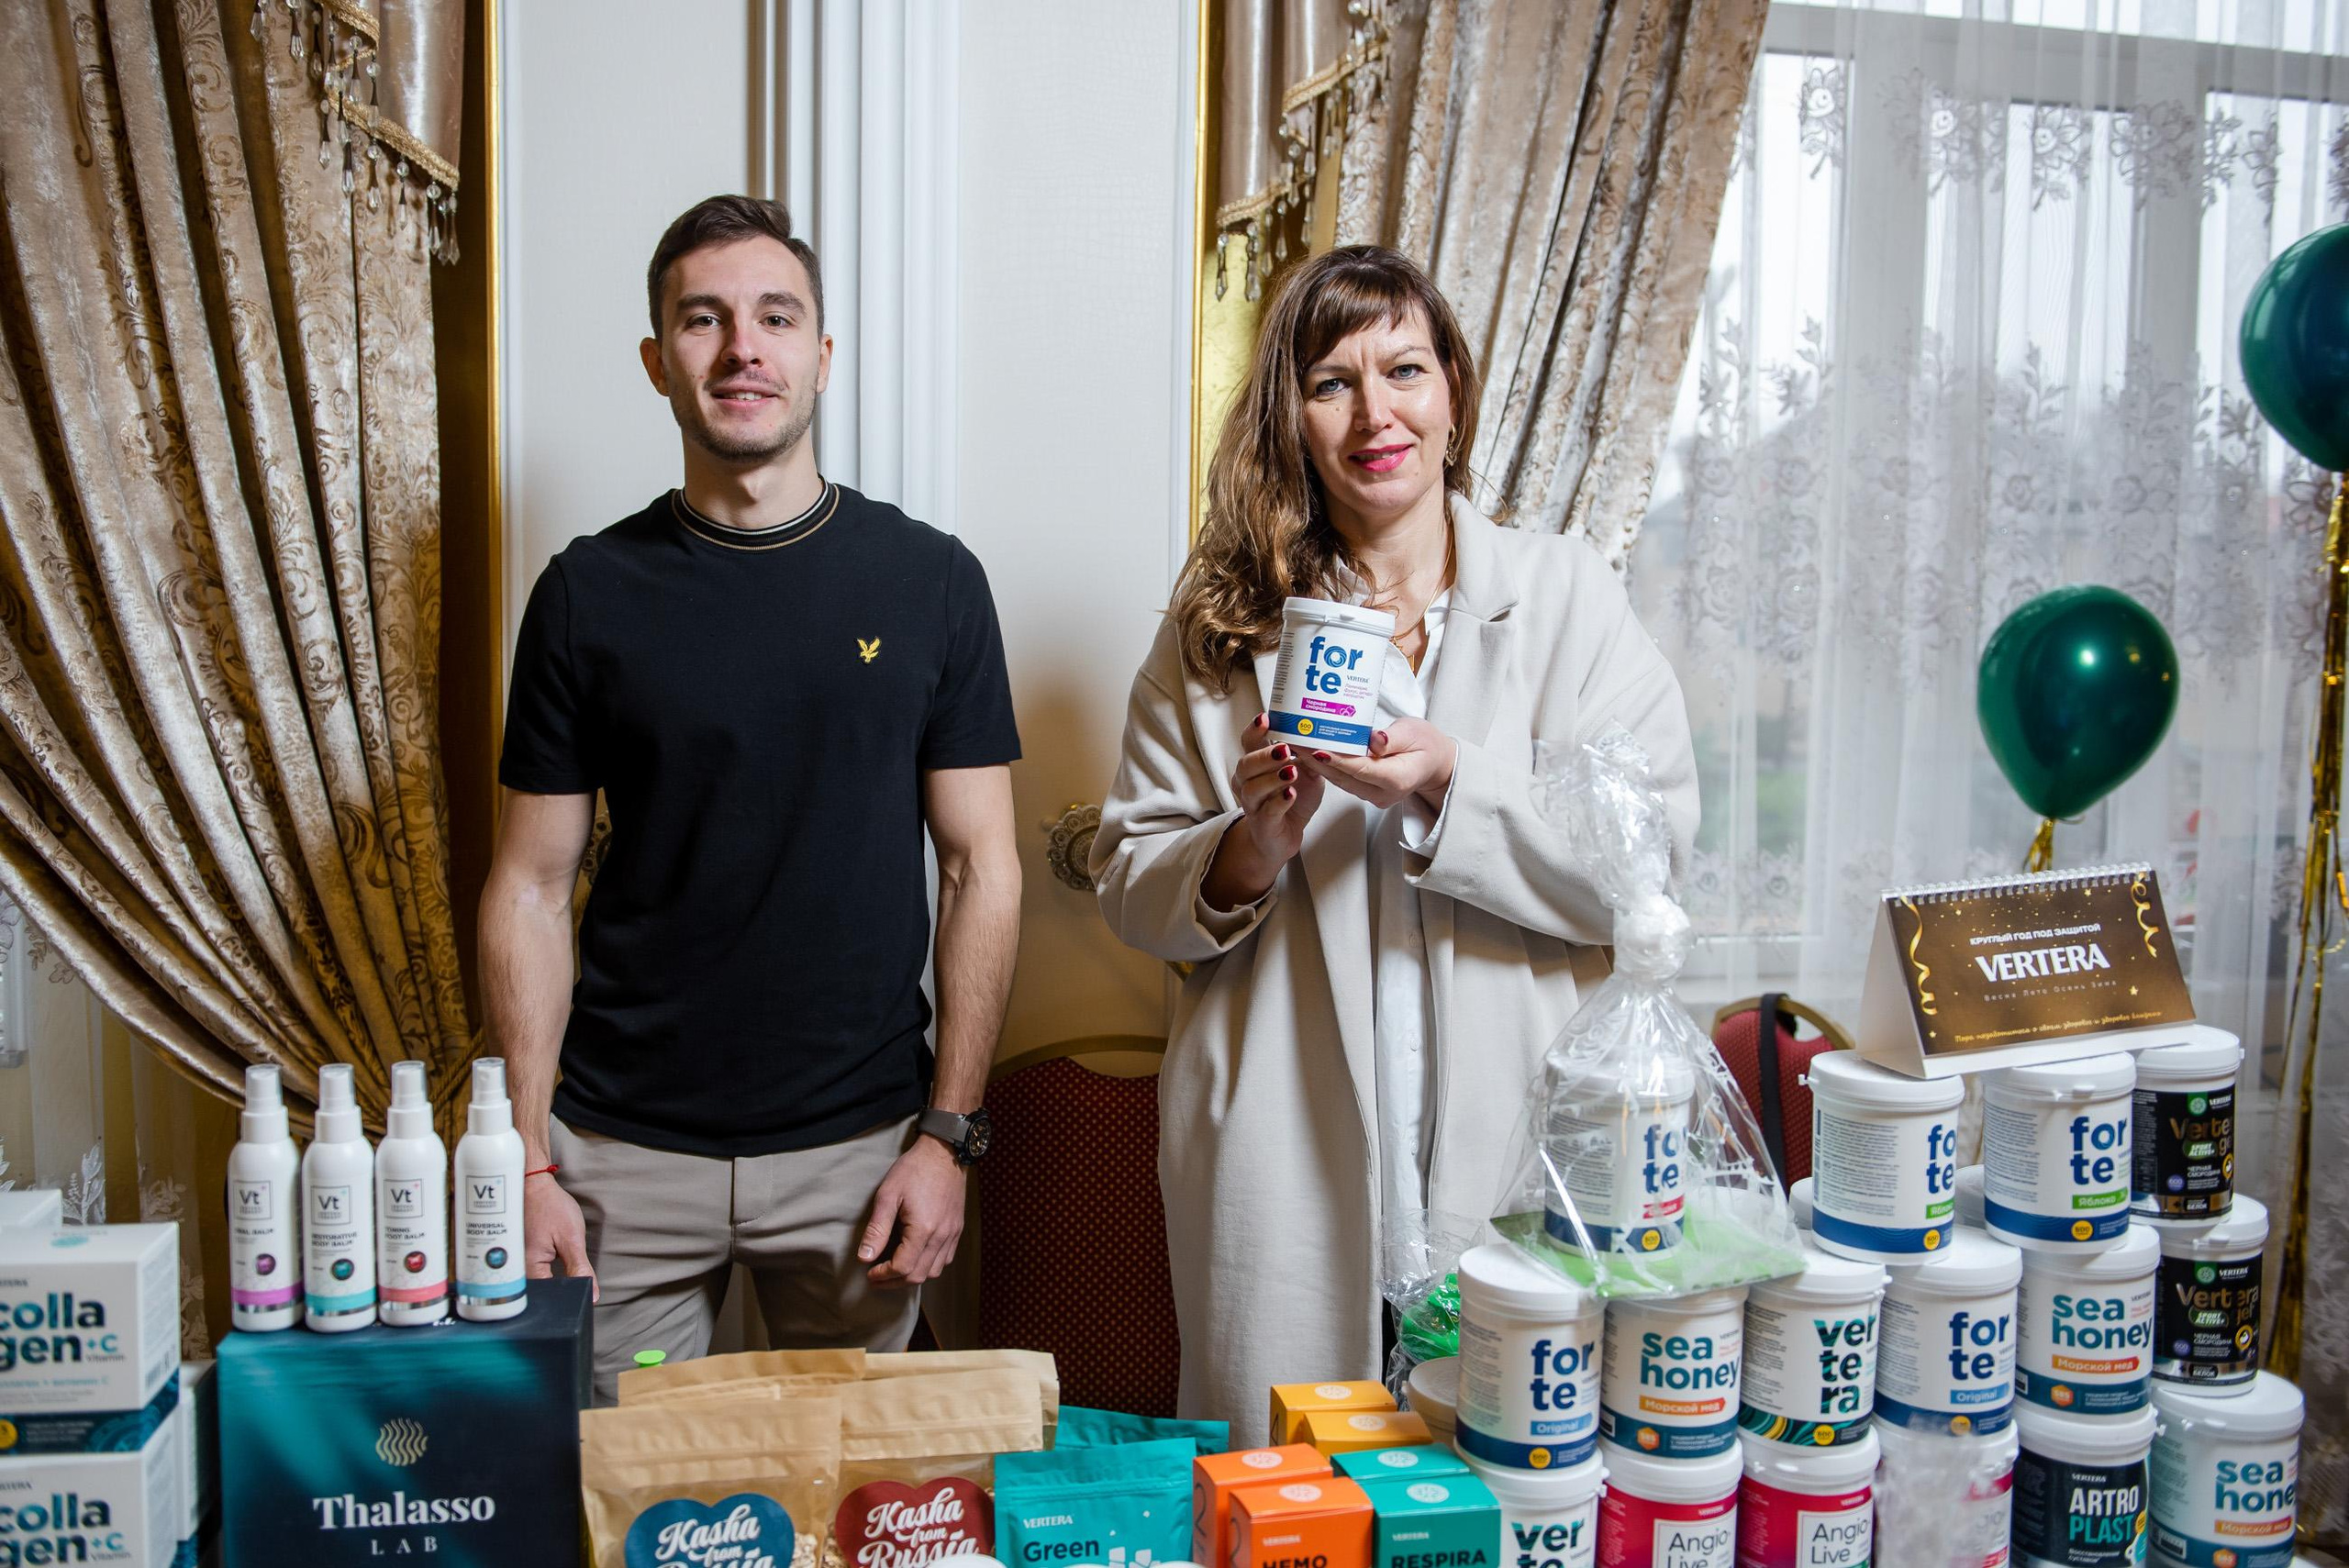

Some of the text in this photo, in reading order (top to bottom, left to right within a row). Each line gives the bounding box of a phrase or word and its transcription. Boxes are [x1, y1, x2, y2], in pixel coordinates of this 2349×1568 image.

[1309, 636, 1364, 671] for
[1305, 664, 1341, 695] te
[1969, 923, 2102, 946] КРУГЛЫЙ ГОД ПОД ЗАЩИТОЙ
[1974, 942, 2111, 983] VERTERA
[1983, 980, 2117, 1002] Весна Лето Осень Зима
[2069, 1116, 2128, 1151] for
[1642, 1161, 1679, 1194] te
[1926, 1162, 1954, 1195] te
[2069, 1152, 2114, 1185] te
[239, 1189, 260, 1206] Vt
[317, 1195, 340, 1210] Vt
[391, 1188, 412, 1204] Vt
[473, 1184, 495, 1200] Vt
[2078, 1195, 2116, 1207] Яблоко
[2219, 1267, 2249, 1277] VERTERA
[2052, 1294, 2125, 1321] sea
[1812, 1314, 1877, 1347] ver
[1948, 1311, 2010, 1347] for
[2052, 1317, 2153, 1350] honey
[1531, 1340, 1595, 1375] for
[1641, 1331, 1713, 1361] sea
[1640, 1354, 1741, 1390] honey
[1819, 1350, 1863, 1383] te
[1948, 1348, 1995, 1381] te
[2058, 1358, 2134, 1372] Морской мед
[1530, 1377, 1576, 1411] te
[1644, 1399, 1721, 1413] Морской мед
[1820, 1385, 1861, 1415] ra
[1955, 1390, 1998, 1403] Original
[1536, 1420, 1580, 1435] Original
[2215, 1460, 2284, 1485] sea
[312, 1491, 496, 1529] Thalasso
[864, 1486, 964, 1539] Kasha
[2068, 1485, 2140, 1517] ARTRO
[655, 1503, 761, 1561] Kasha
[1022, 1515, 1074, 1529] VERTERA
[1511, 1518, 1586, 1552] ver
[2068, 1514, 2134, 1545] PLAST
[2221, 1520, 2273, 1534] Морской
[895, 1526, 948, 1549] from
[1023, 1540, 1100, 1562] Green
[688, 1545, 743, 1567] from
[1390, 1549, 1487, 1568] RESPIRA
[1811, 1545, 1852, 1565] Live
